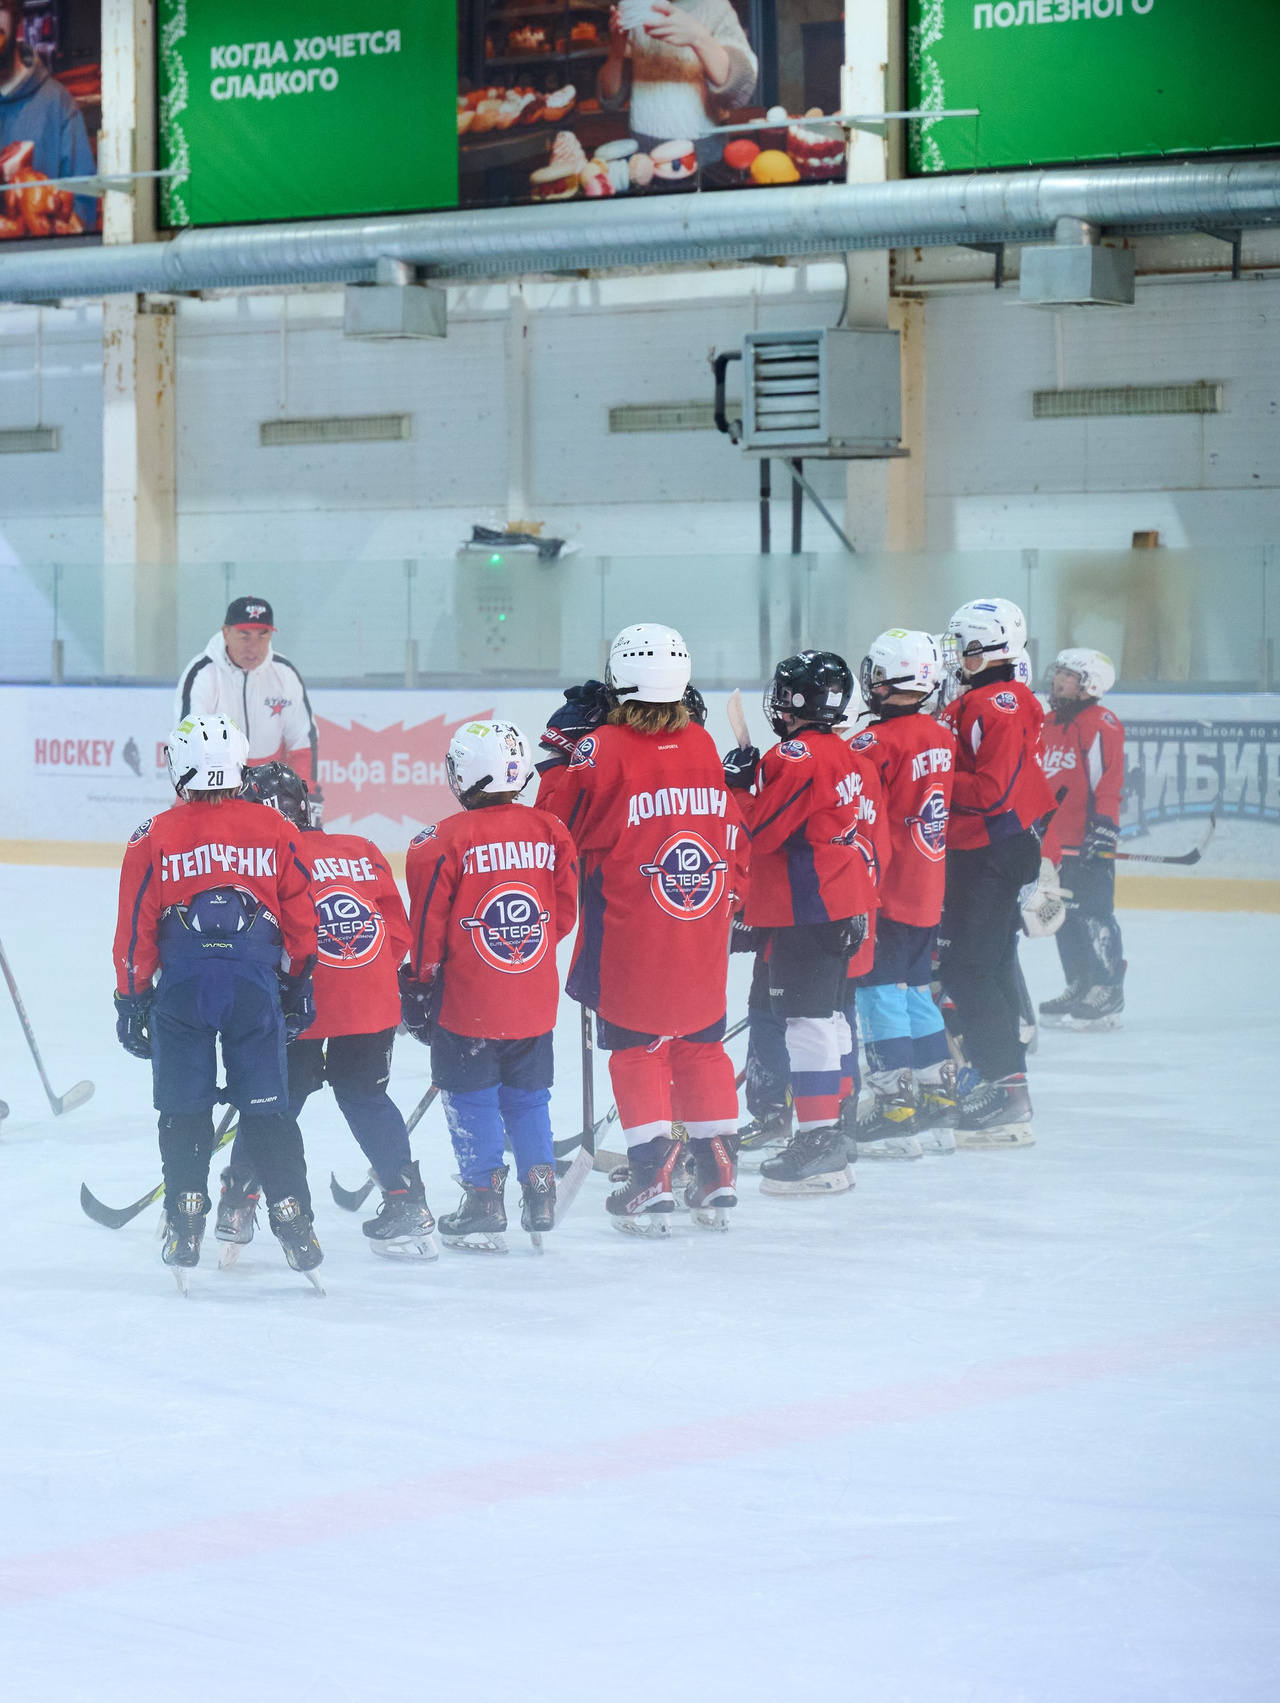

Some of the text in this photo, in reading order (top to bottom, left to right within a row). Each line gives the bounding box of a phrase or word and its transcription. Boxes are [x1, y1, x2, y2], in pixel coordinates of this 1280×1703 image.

[210, 29, 402, 70] КОГДА ХОЧЕТСЯ
[210, 67, 339, 101] СЛАДКОГО
[1203, 726, 1244, 737] ШКОЛА
[34, 739, 115, 766] HOCKEY
[207, 770, 224, 787] 20
[317, 752, 448, 792] льфа Бан
[161, 843, 277, 882] СТЕПЧЕНК
[676, 848, 700, 871] 10
[665, 874, 711, 886] STEPS
[320, 899, 360, 921] 10
[496, 900, 531, 924] 10
[318, 921, 375, 937] STEPS
[488, 924, 541, 940] STEPS
[626, 1182, 663, 1213] CCM
